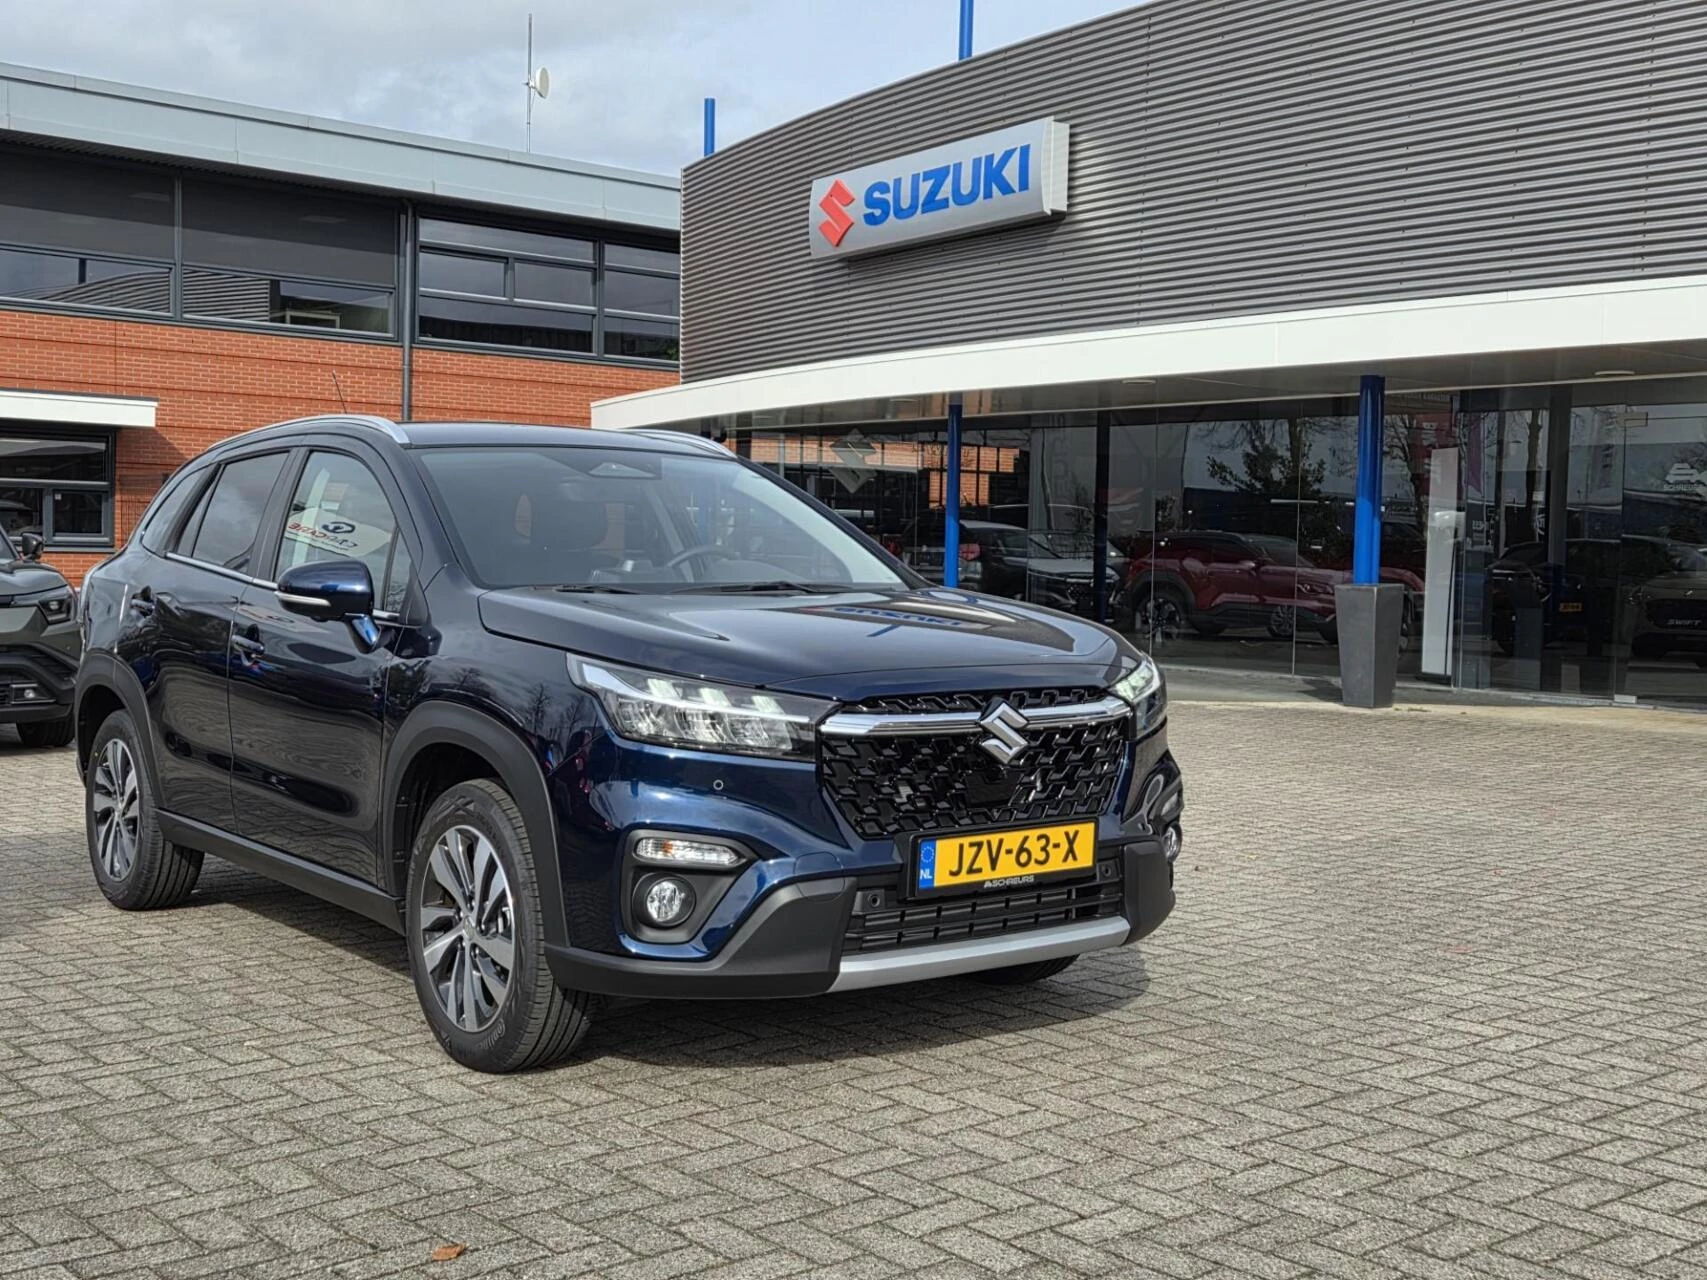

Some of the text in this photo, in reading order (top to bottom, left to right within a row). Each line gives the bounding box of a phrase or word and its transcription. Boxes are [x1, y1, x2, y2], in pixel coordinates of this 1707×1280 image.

[863, 144, 1031, 226] SUZUKI
[920, 868, 933, 880] NL
[949, 830, 1080, 877] JZV-63-X
